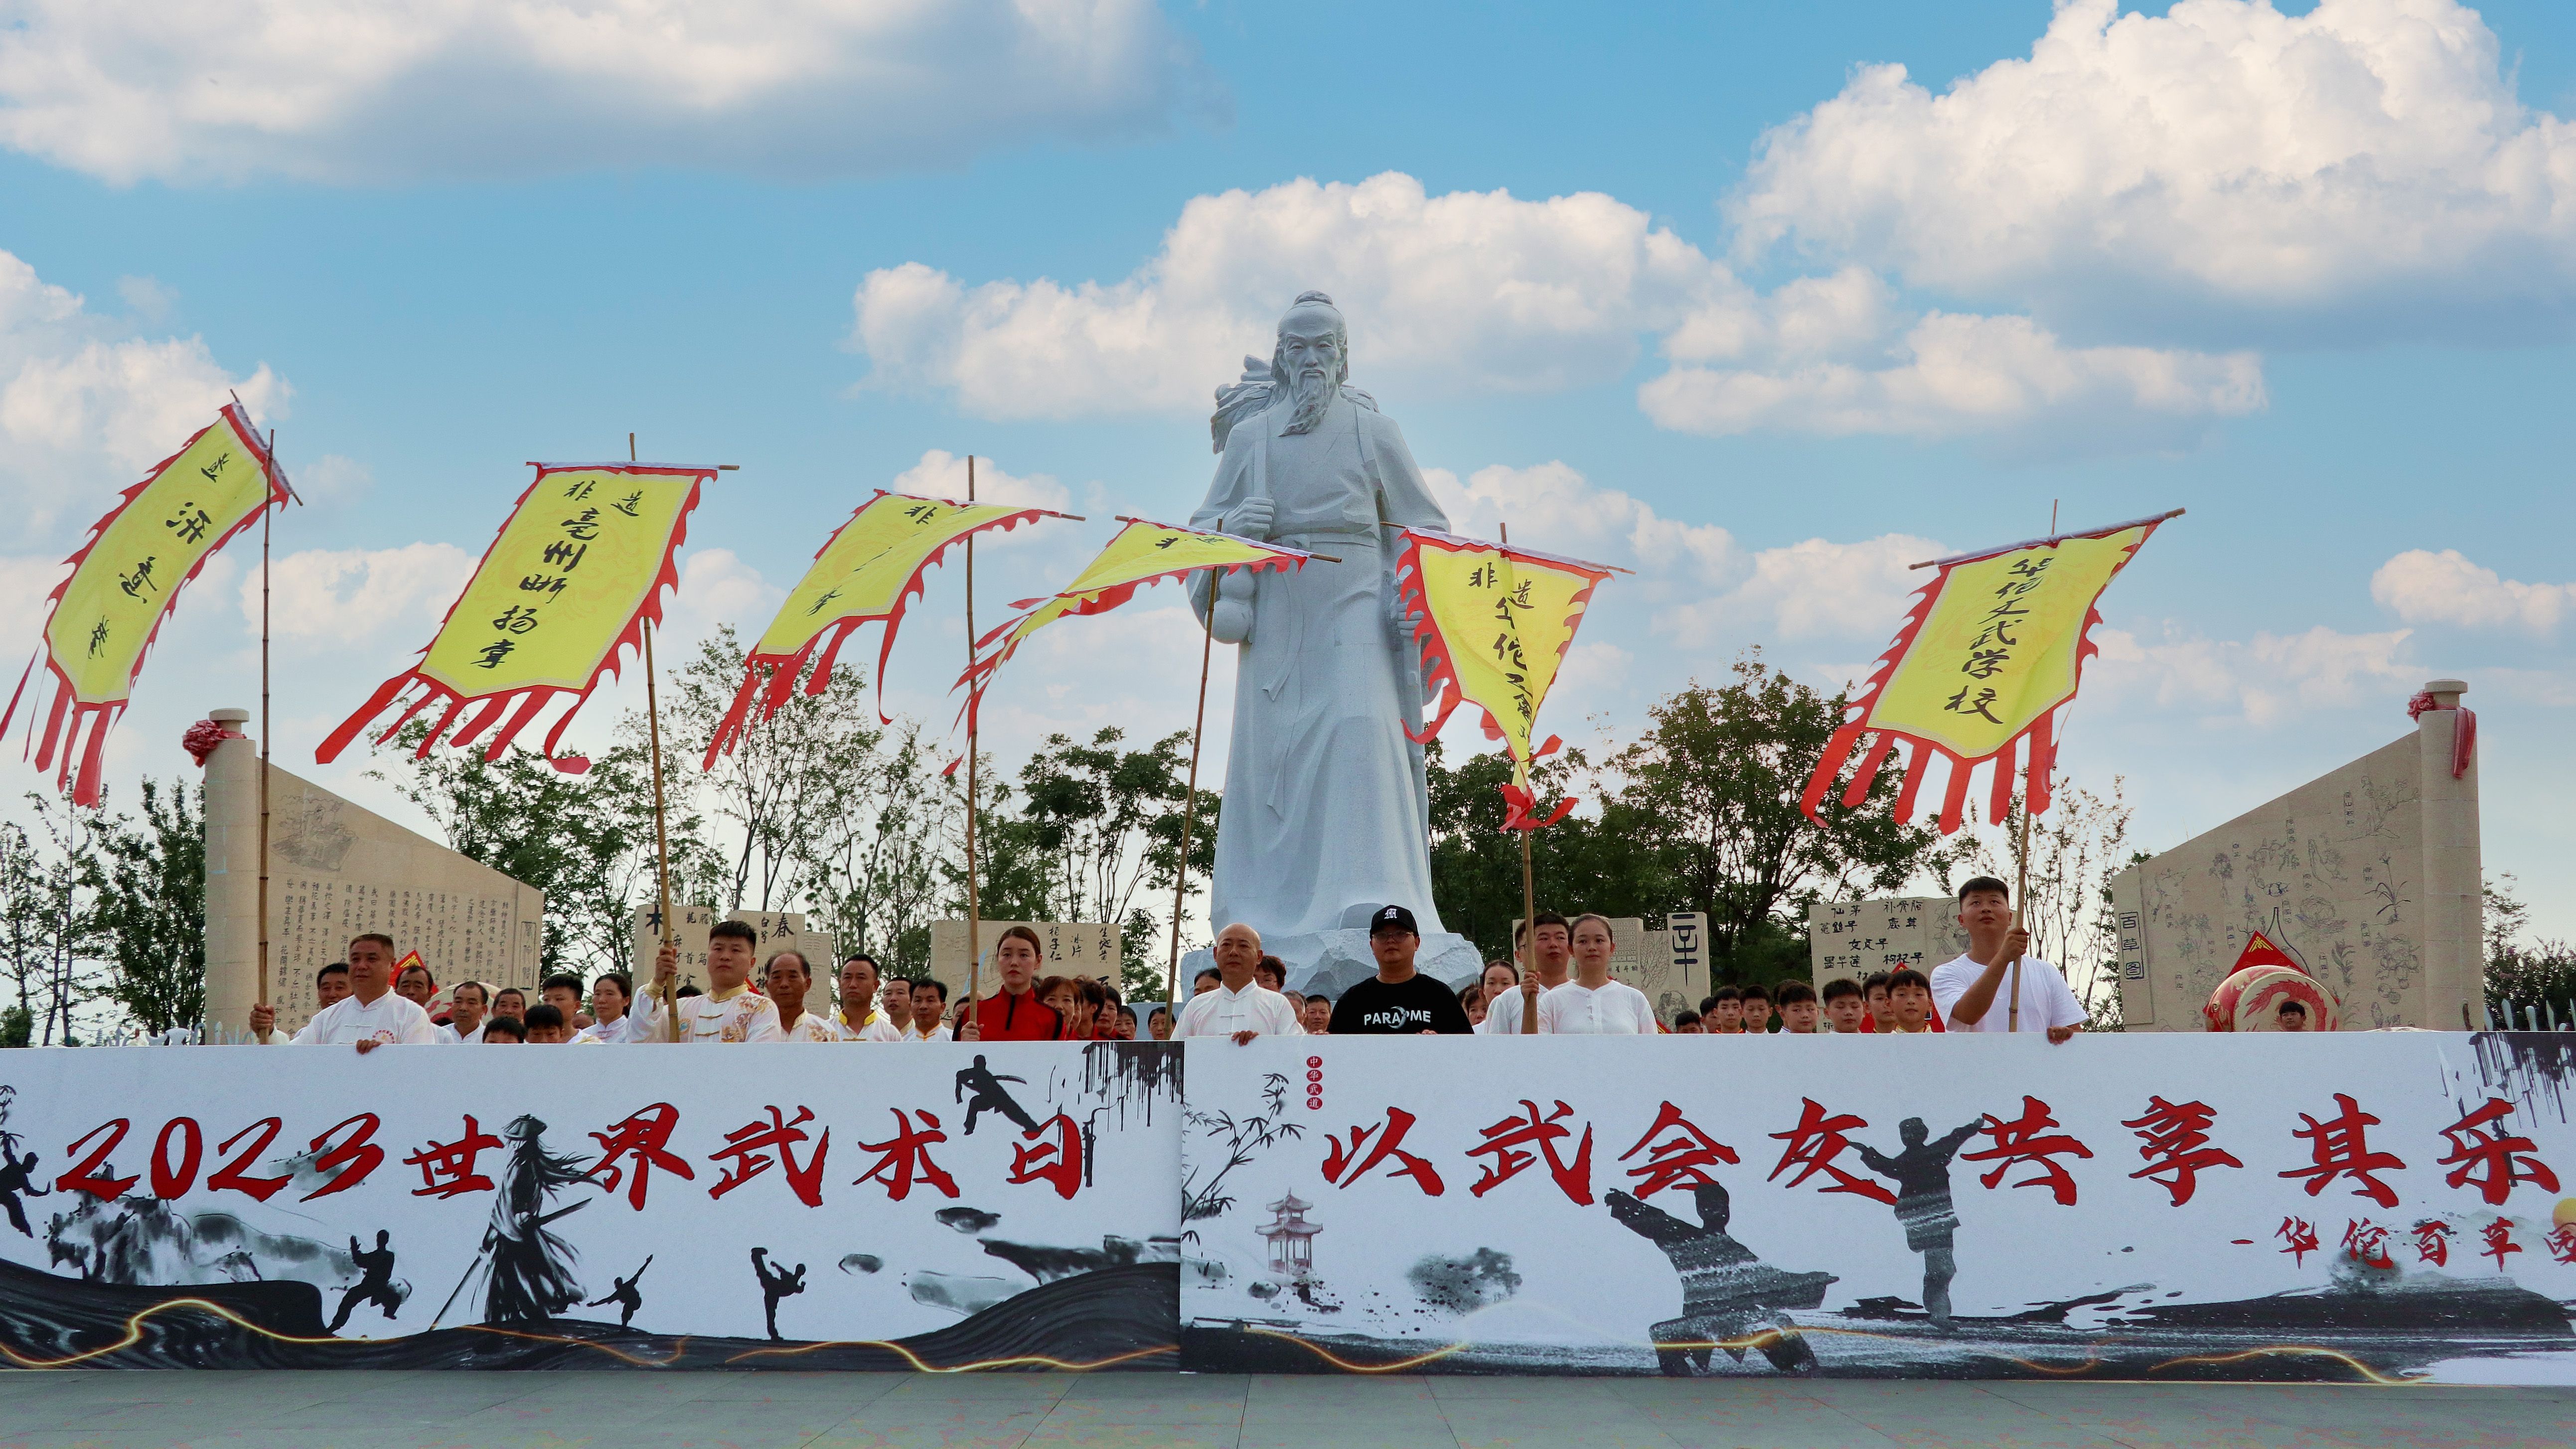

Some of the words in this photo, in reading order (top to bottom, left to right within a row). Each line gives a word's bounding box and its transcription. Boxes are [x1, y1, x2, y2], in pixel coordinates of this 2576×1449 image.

[1944, 557, 2054, 725] 华佗文武学校
[771, 913, 795, 938] 春
[2121, 916, 2141, 976] 百草图
[1308, 1056, 1320, 1108] 中华武道
